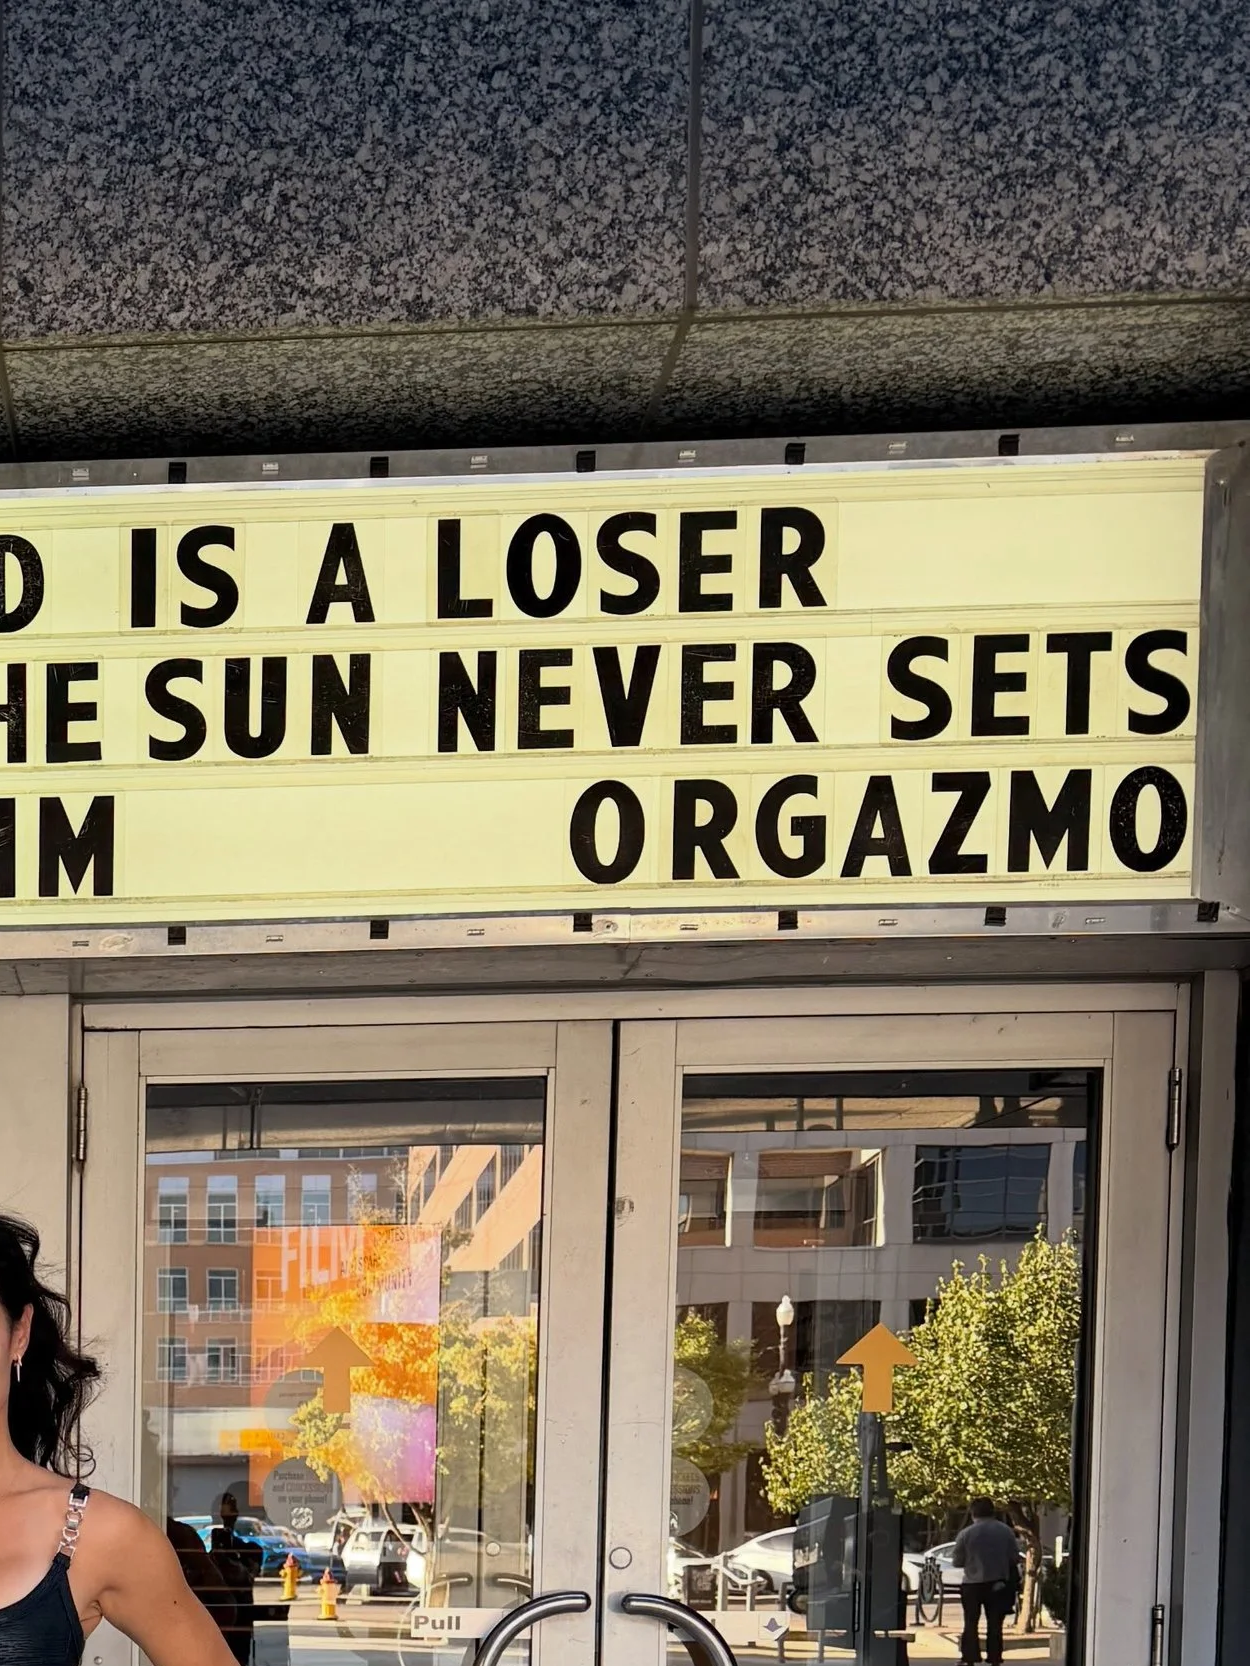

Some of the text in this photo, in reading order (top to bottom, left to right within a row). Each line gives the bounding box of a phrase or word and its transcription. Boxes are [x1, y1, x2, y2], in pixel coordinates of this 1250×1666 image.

[131, 525, 238, 628] IS
[306, 523, 375, 624] A
[438, 507, 827, 619] LOSER
[145, 654, 370, 761] SUN
[438, 642, 818, 752] NEVER
[888, 630, 1190, 740] SETS
[570, 766, 1187, 884] ORGAZMO
[414, 1615, 461, 1630] Pull
